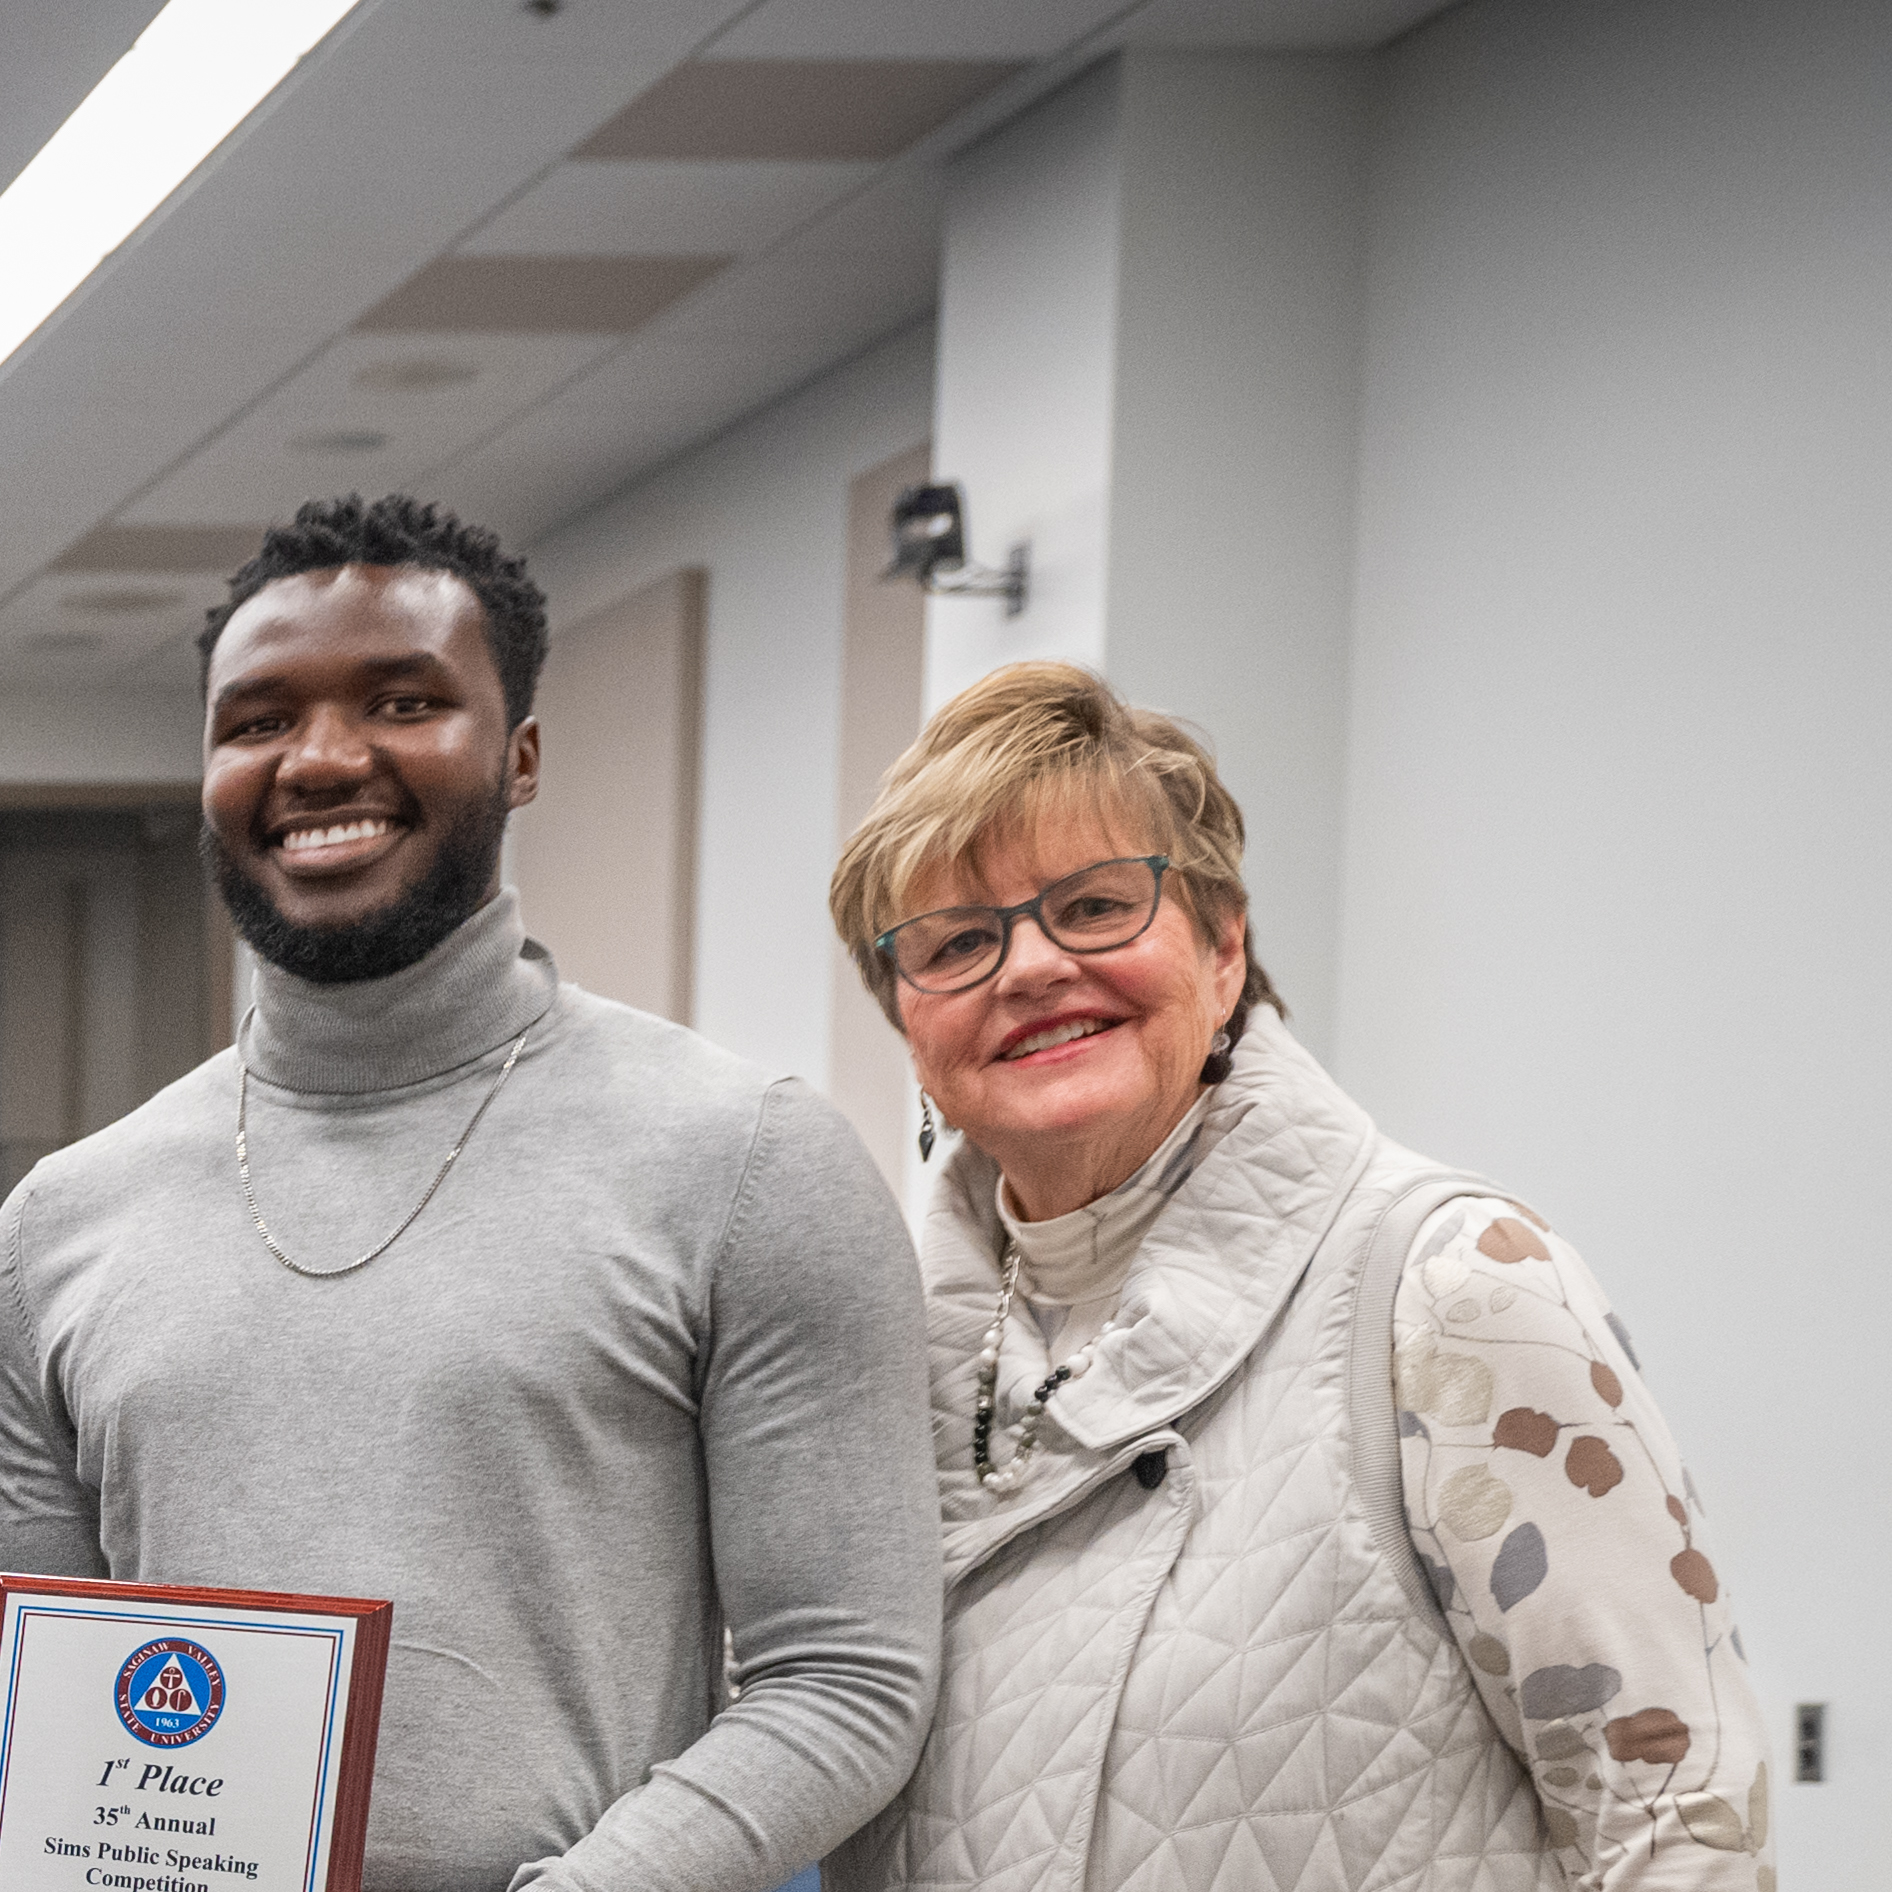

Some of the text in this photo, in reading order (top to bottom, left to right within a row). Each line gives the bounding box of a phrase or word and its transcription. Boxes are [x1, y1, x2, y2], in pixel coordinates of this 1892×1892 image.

[123, 1642, 221, 1686] SAGINAW VALLEY
[119, 1693, 220, 1745] STATE UNIVERSITY
[154, 1717, 180, 1729] 1963
[96, 1758, 224, 1797] 1st Place
[93, 1804, 216, 1836] 35th Annual
[43, 1836, 259, 1880] Sims Public Speaking
